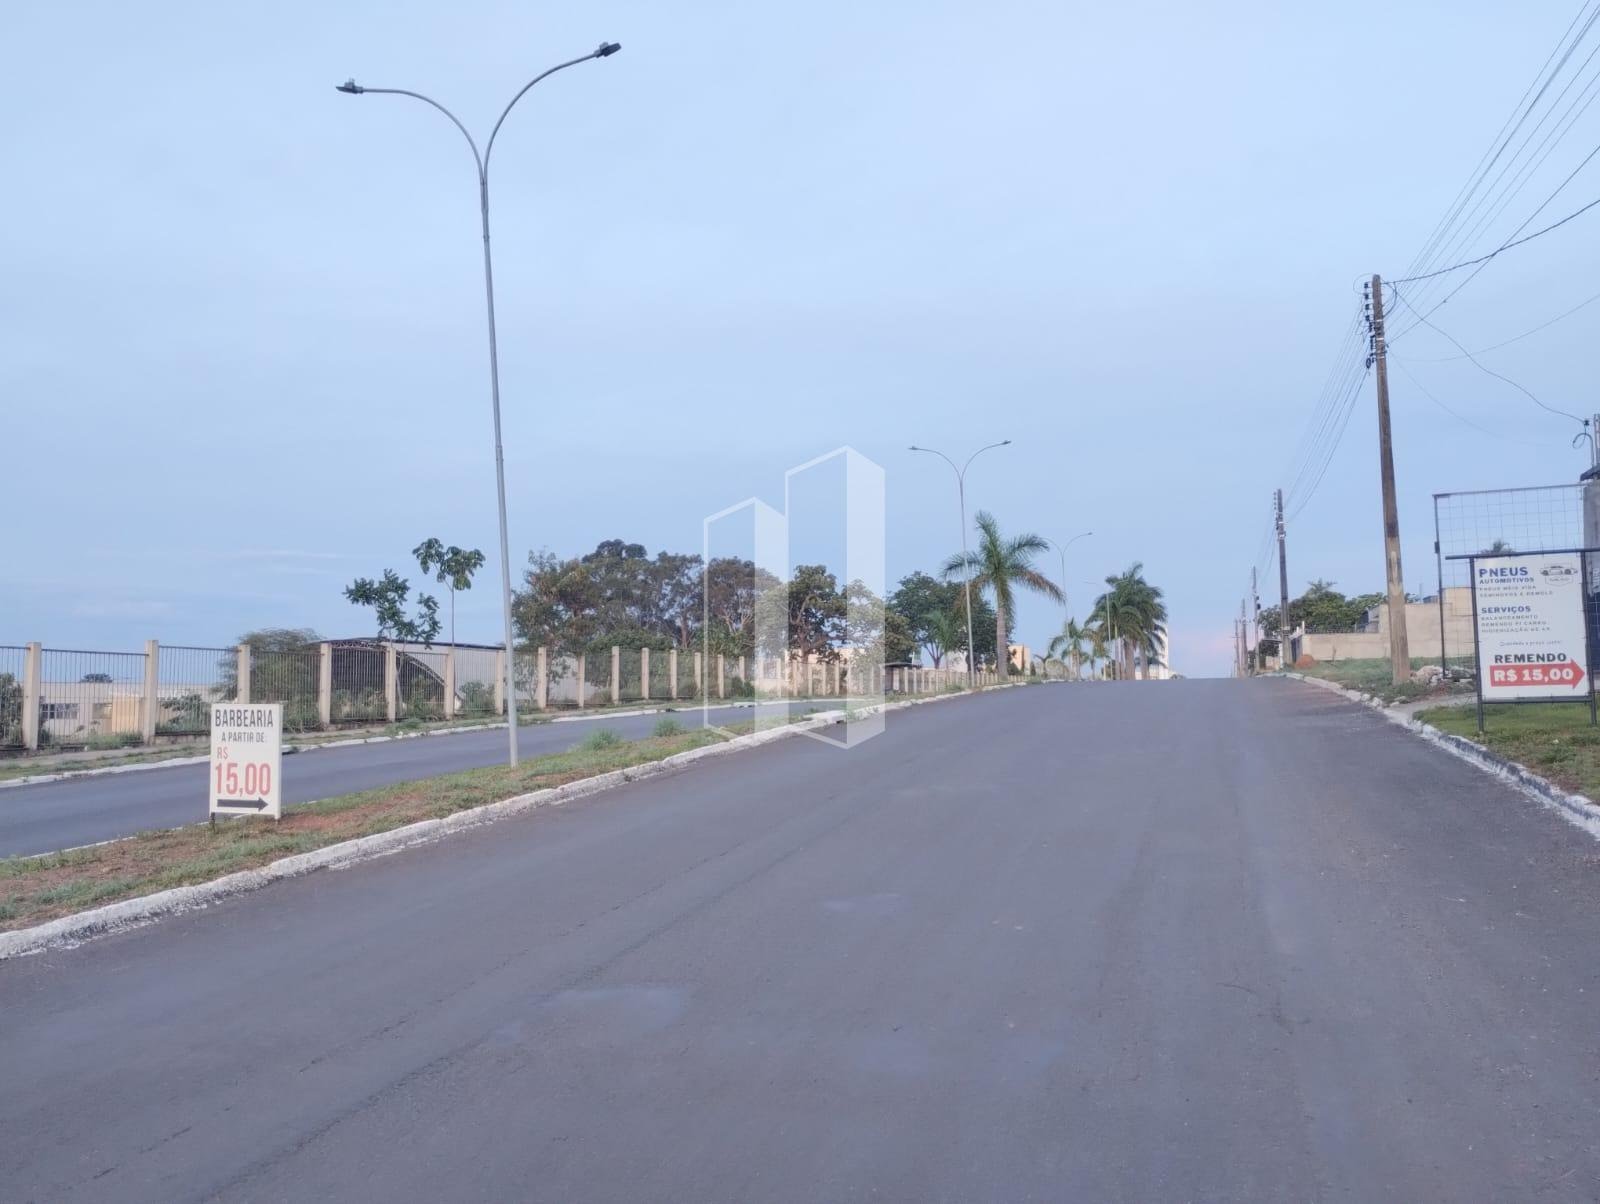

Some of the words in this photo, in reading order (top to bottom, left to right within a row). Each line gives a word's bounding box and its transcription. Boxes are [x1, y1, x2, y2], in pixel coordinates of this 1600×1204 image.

[1479, 567, 1528, 577] PNEUS
[1481, 606, 1531, 614] SERVIÇOS
[1494, 653, 1567, 664] REMENDO
[1494, 669, 1518, 682] R$
[1522, 668, 1574, 683] 15,00
[215, 709, 273, 728] BARBEARIA
[221, 733, 226, 741] A
[228, 732, 254, 743] PARTIR
[217, 747, 228, 760] R$
[215, 763, 271, 796] 15,00
